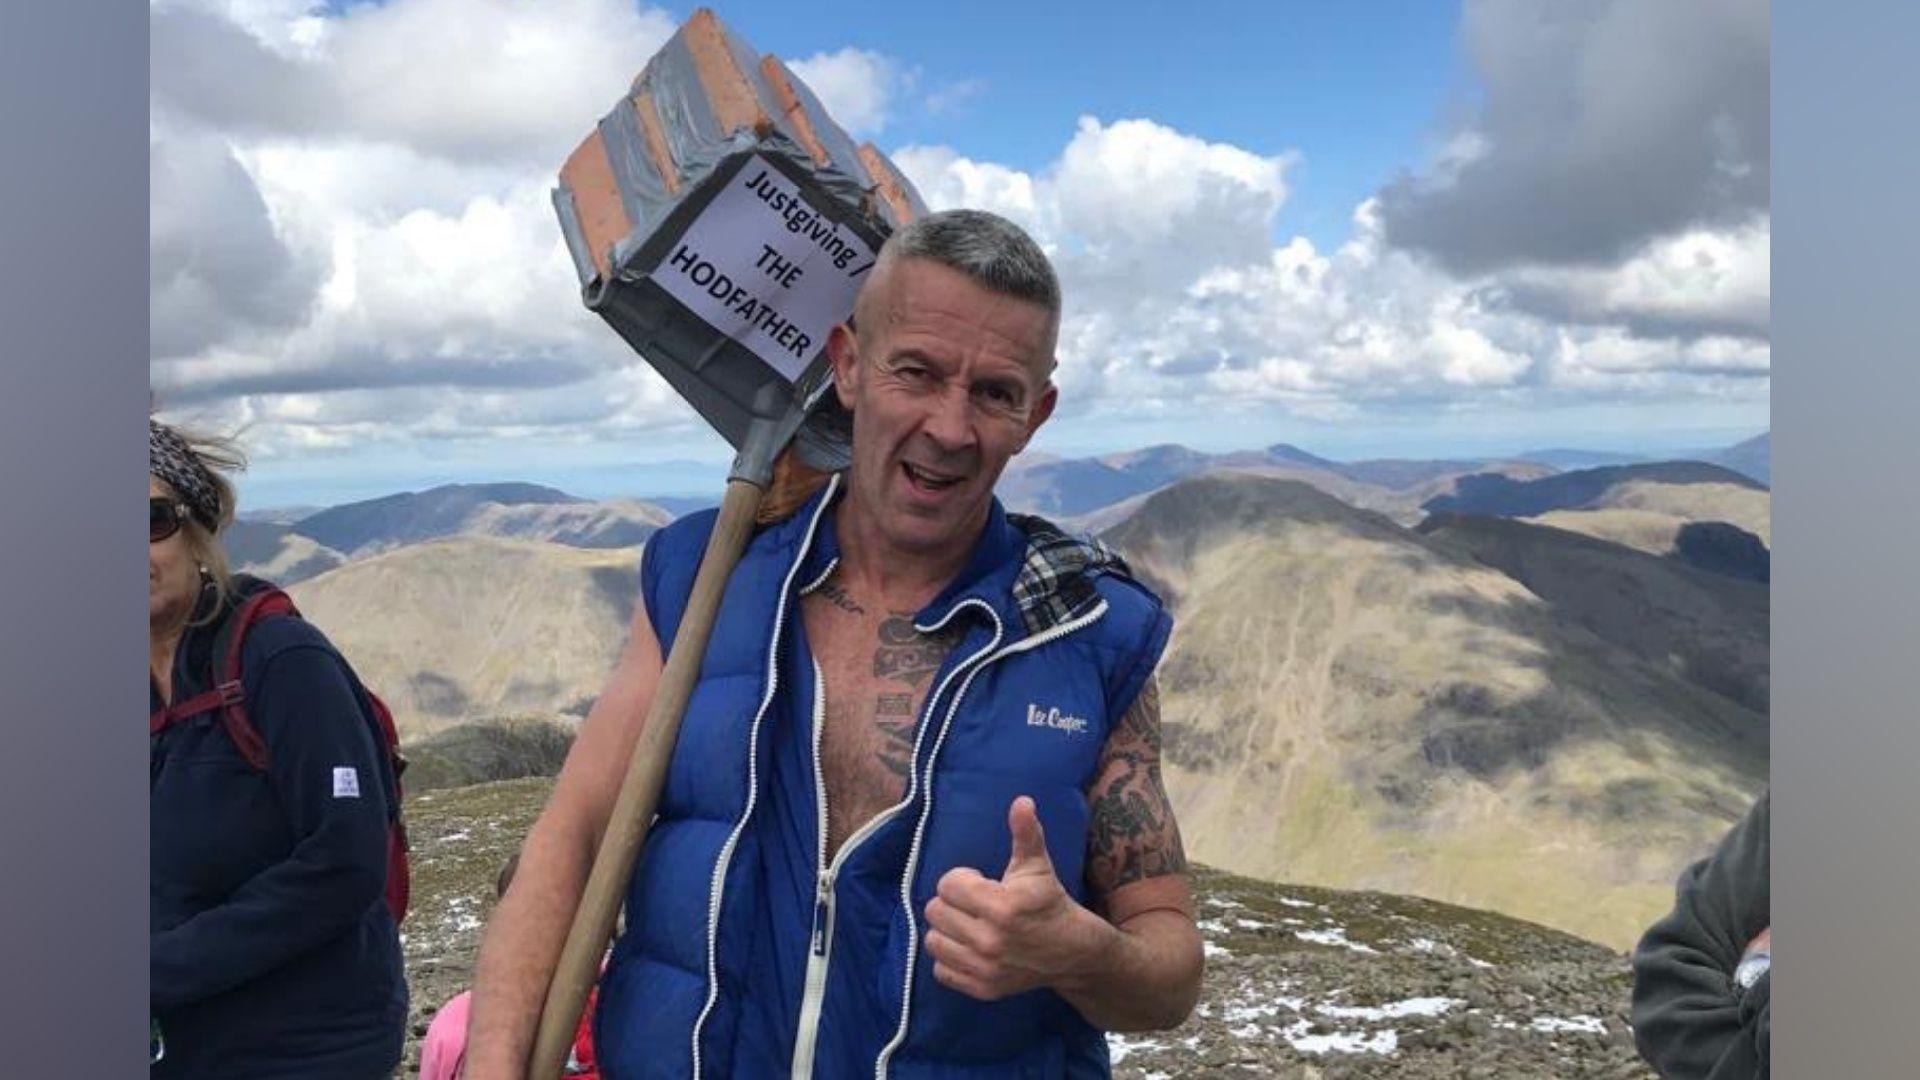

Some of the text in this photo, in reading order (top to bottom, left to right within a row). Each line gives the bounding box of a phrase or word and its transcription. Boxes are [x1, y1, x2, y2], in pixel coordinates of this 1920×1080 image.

[745, 170, 858, 270] Justgiving
[756, 244, 803, 289] THE
[670, 244, 812, 358] HODFATHER
